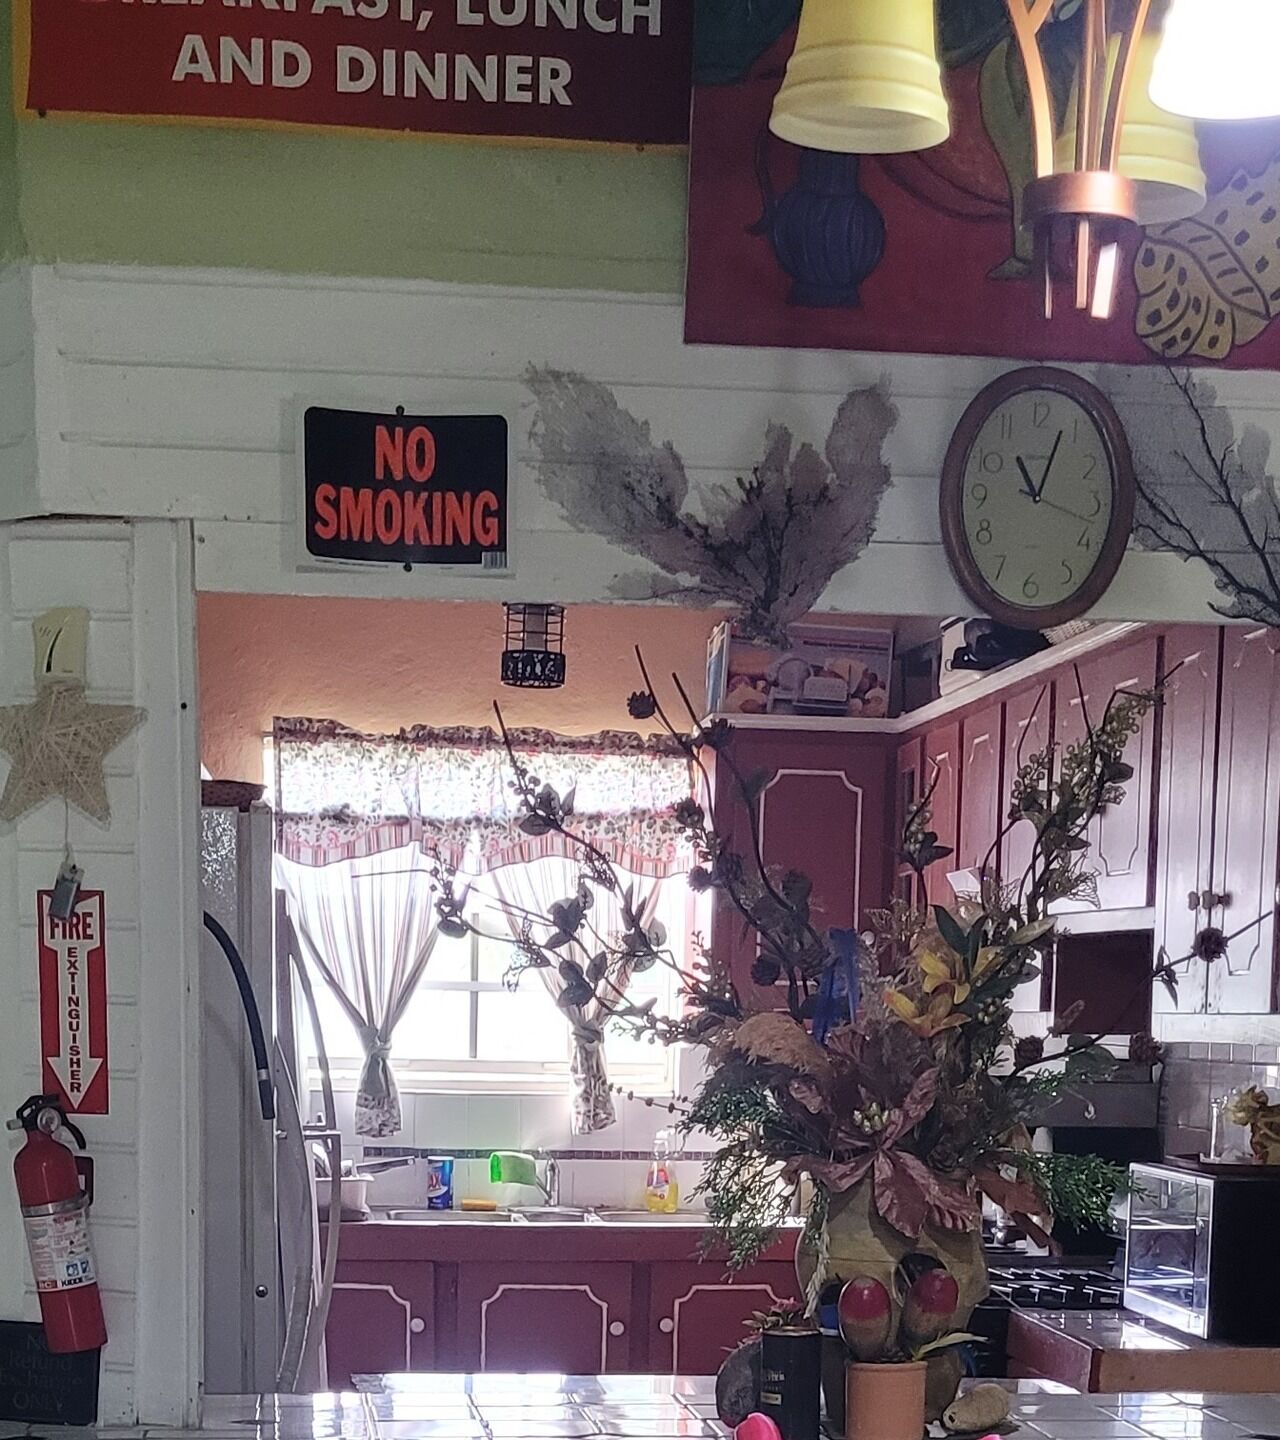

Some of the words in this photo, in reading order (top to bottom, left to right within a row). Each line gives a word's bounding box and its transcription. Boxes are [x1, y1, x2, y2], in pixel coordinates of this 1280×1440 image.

[172, 34, 312, 88] AND
[336, 45, 573, 105] DINNER
[1001, 413, 1013, 439] 11
[1033, 402, 1050, 428] 12
[1073, 418, 1078, 444] 1
[375, 425, 436, 482] NO
[978, 447, 1004, 474] 10
[1082, 454, 1097, 480] 2
[971, 483, 988, 509] 9
[1087, 490, 1101, 517] 3
[314, 483, 499, 547] SMOKING
[975, 518, 993, 545] 8
[1077, 527, 1091, 551] 4
[994, 554, 1007, 581] 7
[1060, 559, 1073, 585] 5
[1022, 572, 1039, 599] 6
[49, 911, 94, 940] FIRE
[66, 946, 82, 1093] EXTINGUISHER
